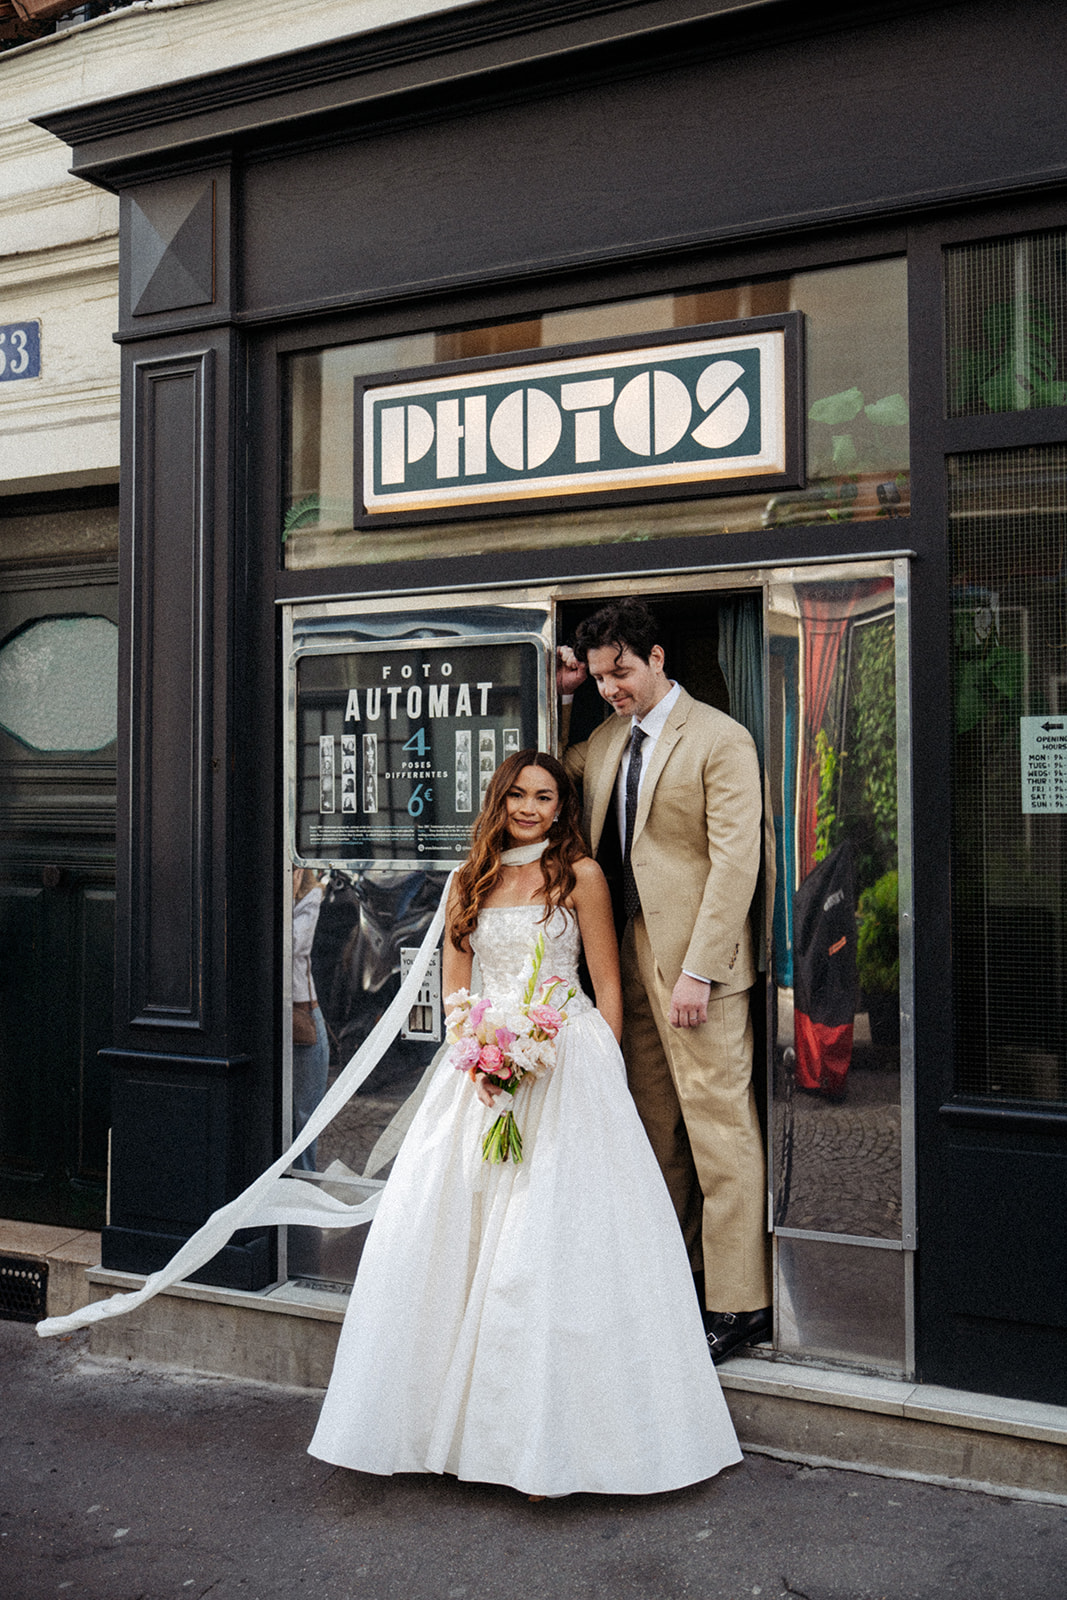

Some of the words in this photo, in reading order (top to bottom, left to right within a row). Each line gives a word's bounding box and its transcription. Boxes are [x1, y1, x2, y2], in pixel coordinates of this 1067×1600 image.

[381, 360, 750, 485] PHOTOS
[382, 662, 453, 679] FOTO
[344, 682, 493, 722] AUTOMAT
[402, 727, 431, 756] 4
[385, 771, 448, 780] DIFFERENTES
[401, 761, 431, 770] POSES
[407, 783, 433, 817] 6€
